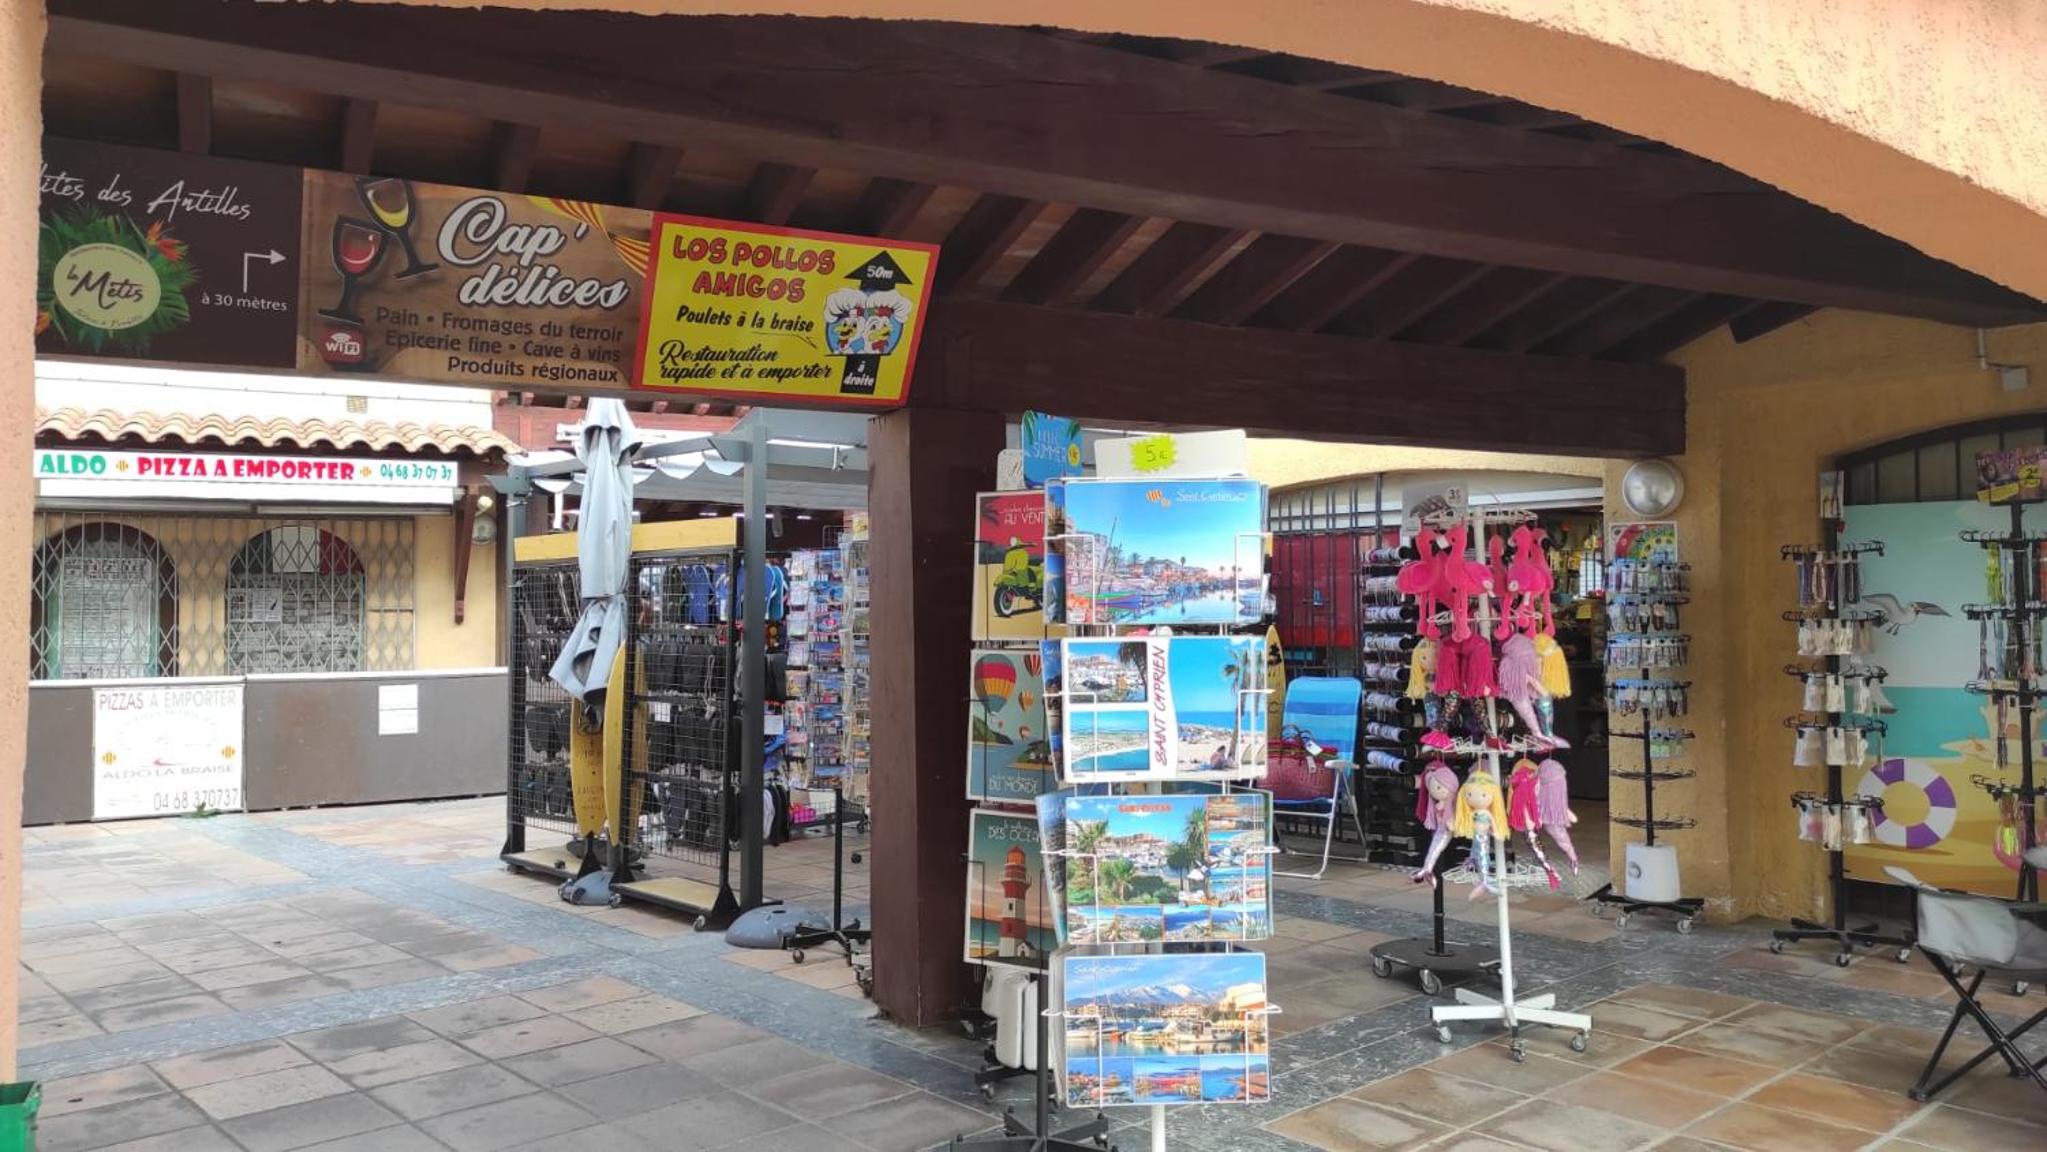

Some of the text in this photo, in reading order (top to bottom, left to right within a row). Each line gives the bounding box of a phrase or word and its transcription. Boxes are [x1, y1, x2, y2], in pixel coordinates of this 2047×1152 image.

[97, 173, 132, 207] des
[147, 179, 251, 223] Antilles
[673, 234, 836, 276] LOS POLLOS
[865, 264, 894, 281] 50m
[458, 262, 630, 311] délices
[692, 270, 807, 304] AMIGOS
[201, 292, 288, 312] à 30 mètres
[375, 306, 624, 343] Pain Fromages du terroir
[676, 304, 815, 333] Poulets à la braise
[385, 328, 621, 363] Epicerie fine Cave à vins
[659, 339, 780, 366] Restauration
[447, 356, 619, 383] Produits régionaux
[659, 365, 717, 384] rapide
[720, 364, 737, 379] et
[756, 365, 833, 384] emporter
[843, 372, 875, 388] droite
[857, 360, 866, 374] à
[39, 453, 453, 481] ALDO PIZZA A EMPORTER 04 68 37 07 37
[98, 692, 144, 711] PIZZAS
[164, 690, 237, 709] EMPORTER
[153, 792, 170, 811] 04
[174, 790, 189, 810] 68
[192, 787, 239, 809] 370737
